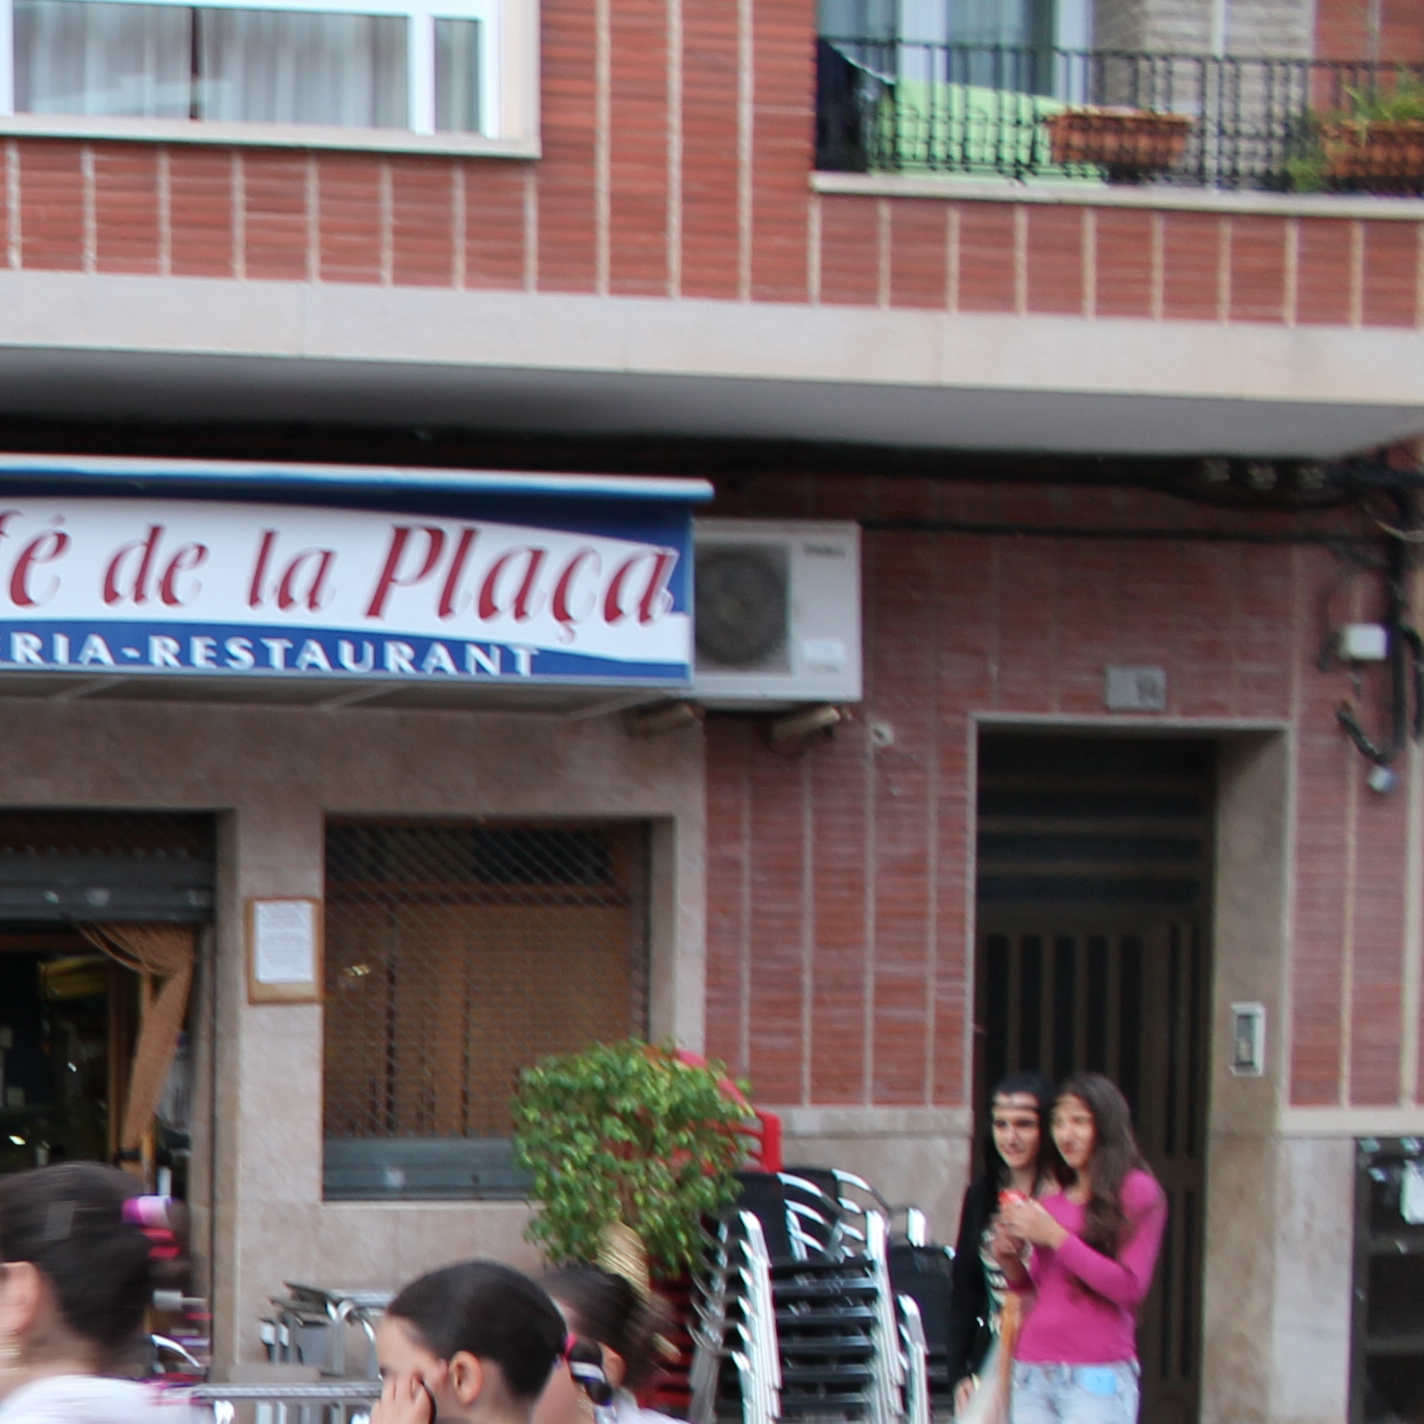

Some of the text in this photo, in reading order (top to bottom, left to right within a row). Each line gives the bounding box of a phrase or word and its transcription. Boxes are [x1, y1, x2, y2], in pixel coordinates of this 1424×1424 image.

[102, 524, 209, 608] de
[247, 528, 338, 613] la
[363, 524, 679, 643] Plaça
